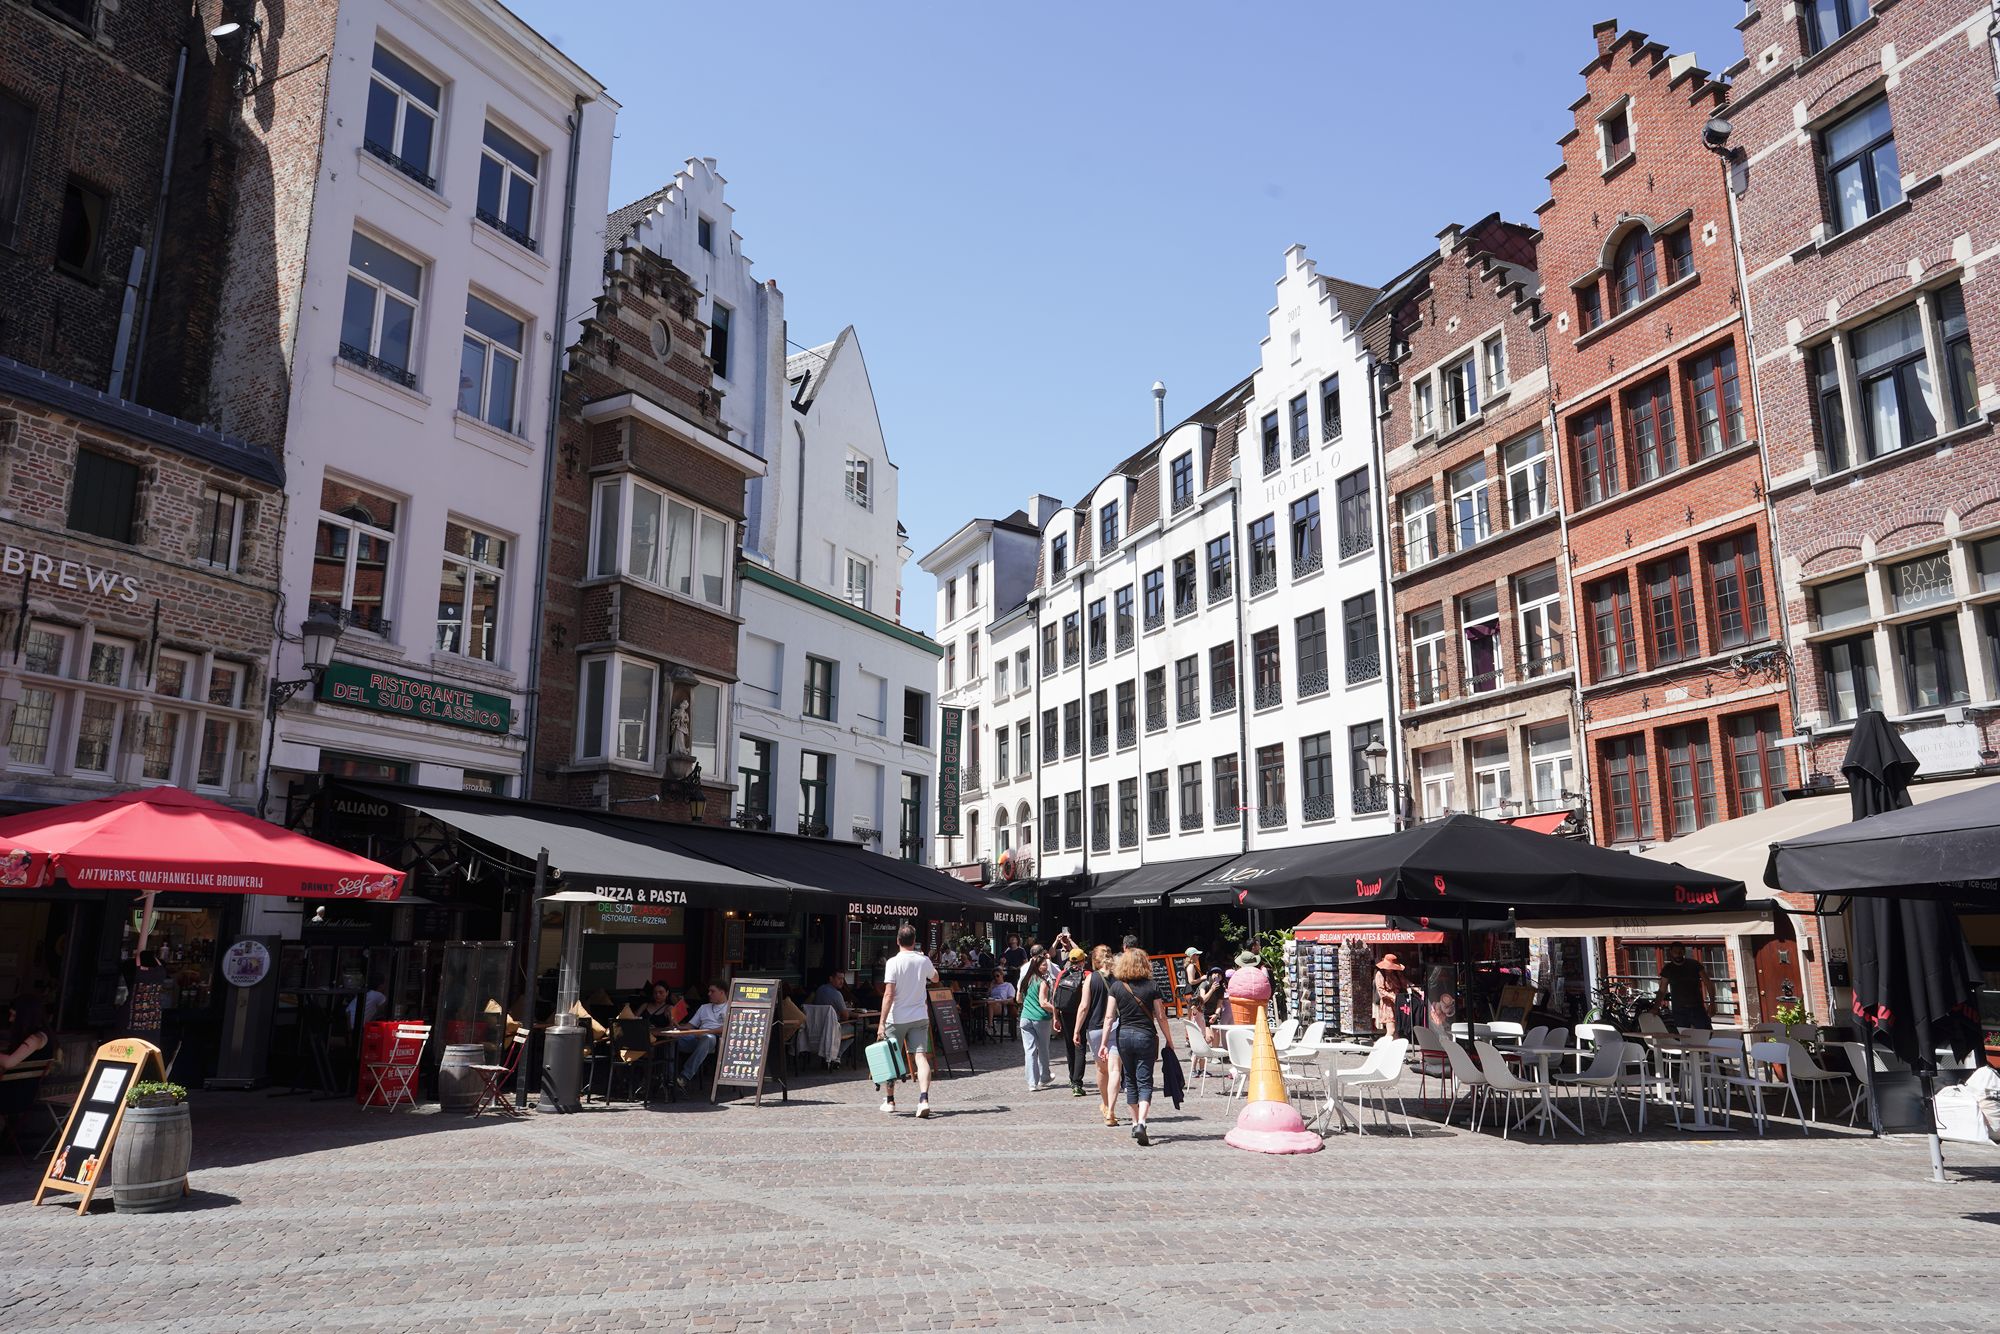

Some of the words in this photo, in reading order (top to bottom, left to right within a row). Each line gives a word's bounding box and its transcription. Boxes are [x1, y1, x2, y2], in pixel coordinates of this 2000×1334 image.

[1266, 461, 1325, 503] HOTEL
[1331, 450, 1341, 469] O
[2, 546, 138, 602] BREWS
[370, 673, 474, 708] RISTORANTE
[333, 682, 369, 704] DEL
[377, 692, 413, 711] SUD
[419, 699, 501, 727] CLASSICO
[945, 711, 958, 737] DEL
[944, 739, 957, 763] SUD
[942, 766, 957, 832] CLASSICO
[77, 868, 137, 882] ANTWERPSE
[138, 871, 215, 887] ONAFHANKELIJKE
[216, 874, 264, 889] BROUWERIJ
[334, 874, 371, 898] Seef
[1355, 877, 1382, 897] Duvel
[595, 886, 634, 901] PIZZA
[636, 889, 646, 902] &
[650, 889, 688, 904] PASTA
[1675, 885, 1720, 905] Duvel
[598, 903, 614, 912] DEL
[615, 903, 632, 914] SUD
[601, 913, 637, 924] RISTORANTE
[642, 916, 667, 925] PIZZERIA
[849, 902, 865, 914] DEL
[866, 903, 882, 915] SUD
[883, 904, 919, 917] CLASSICO
[993, 912, 1009, 922] MEAT
[1015, 913, 1028, 924] FISH
[1319, 932, 1341, 941] BELGIAN
[1341, 932, 1377, 942] CHOCOLATES
[1382, 932, 1415, 941] SOUVENIRS
